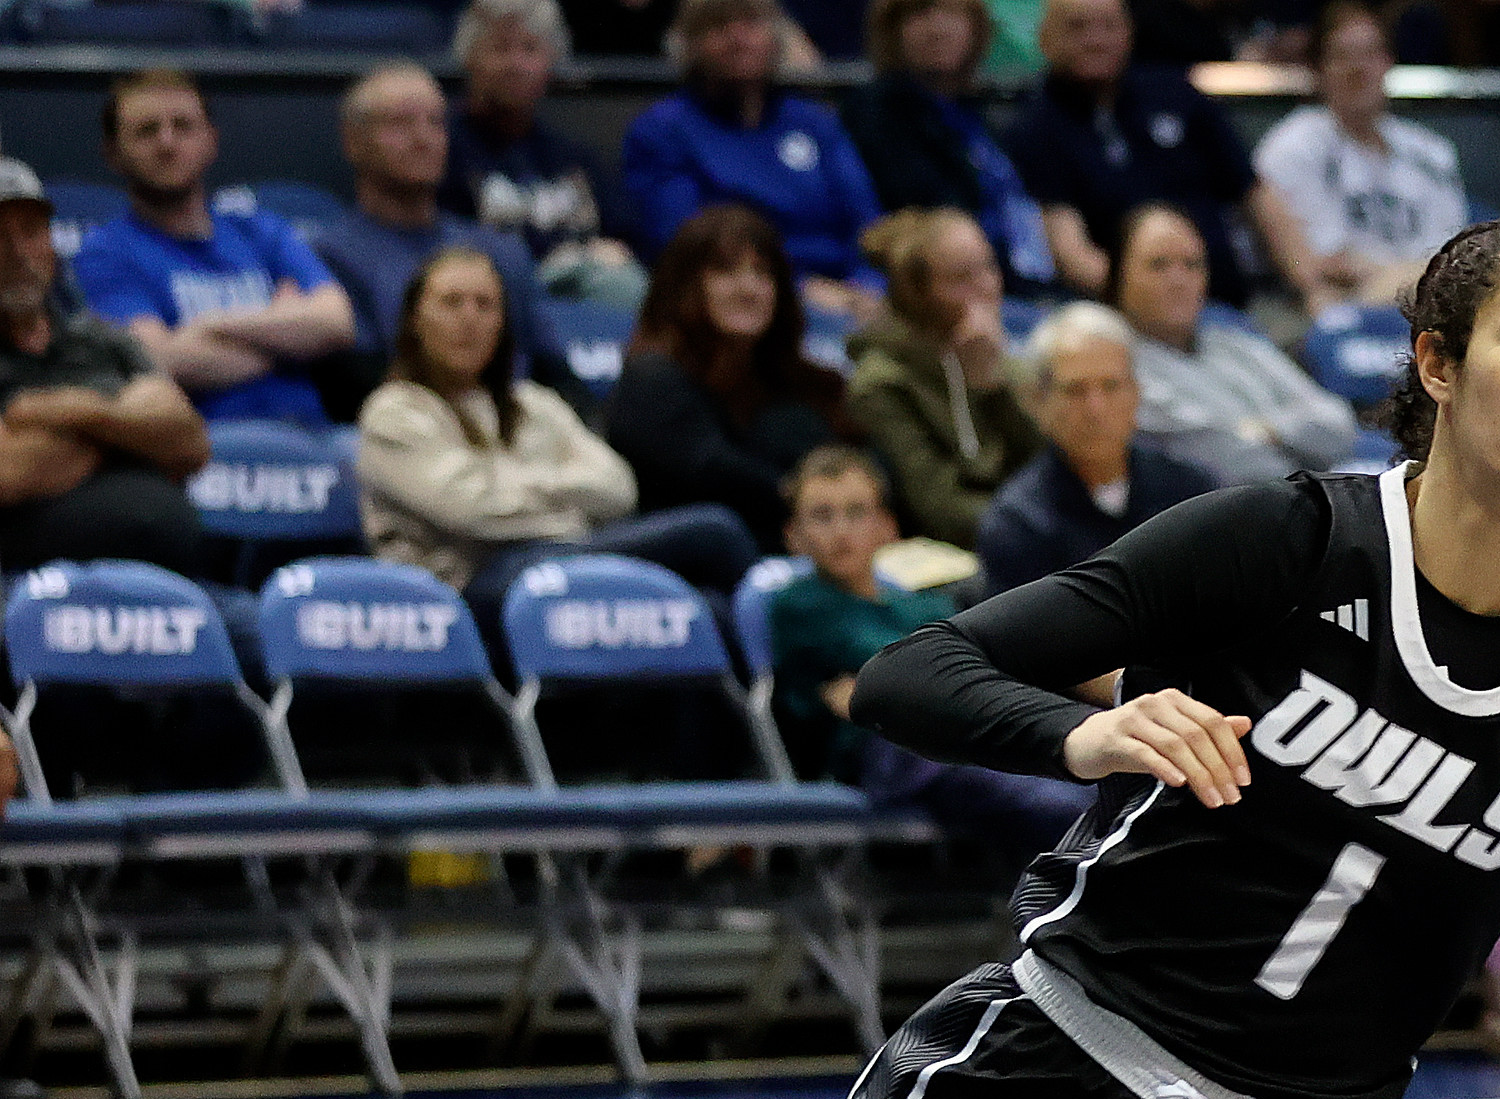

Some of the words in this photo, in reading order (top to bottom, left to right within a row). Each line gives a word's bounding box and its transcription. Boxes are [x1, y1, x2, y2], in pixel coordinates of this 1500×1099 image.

[44, 605, 206, 655] BUILT
[297, 602, 457, 652] BUILT
[546, 599, 700, 648] BUILT
[1253, 841, 1388, 1001] 1
